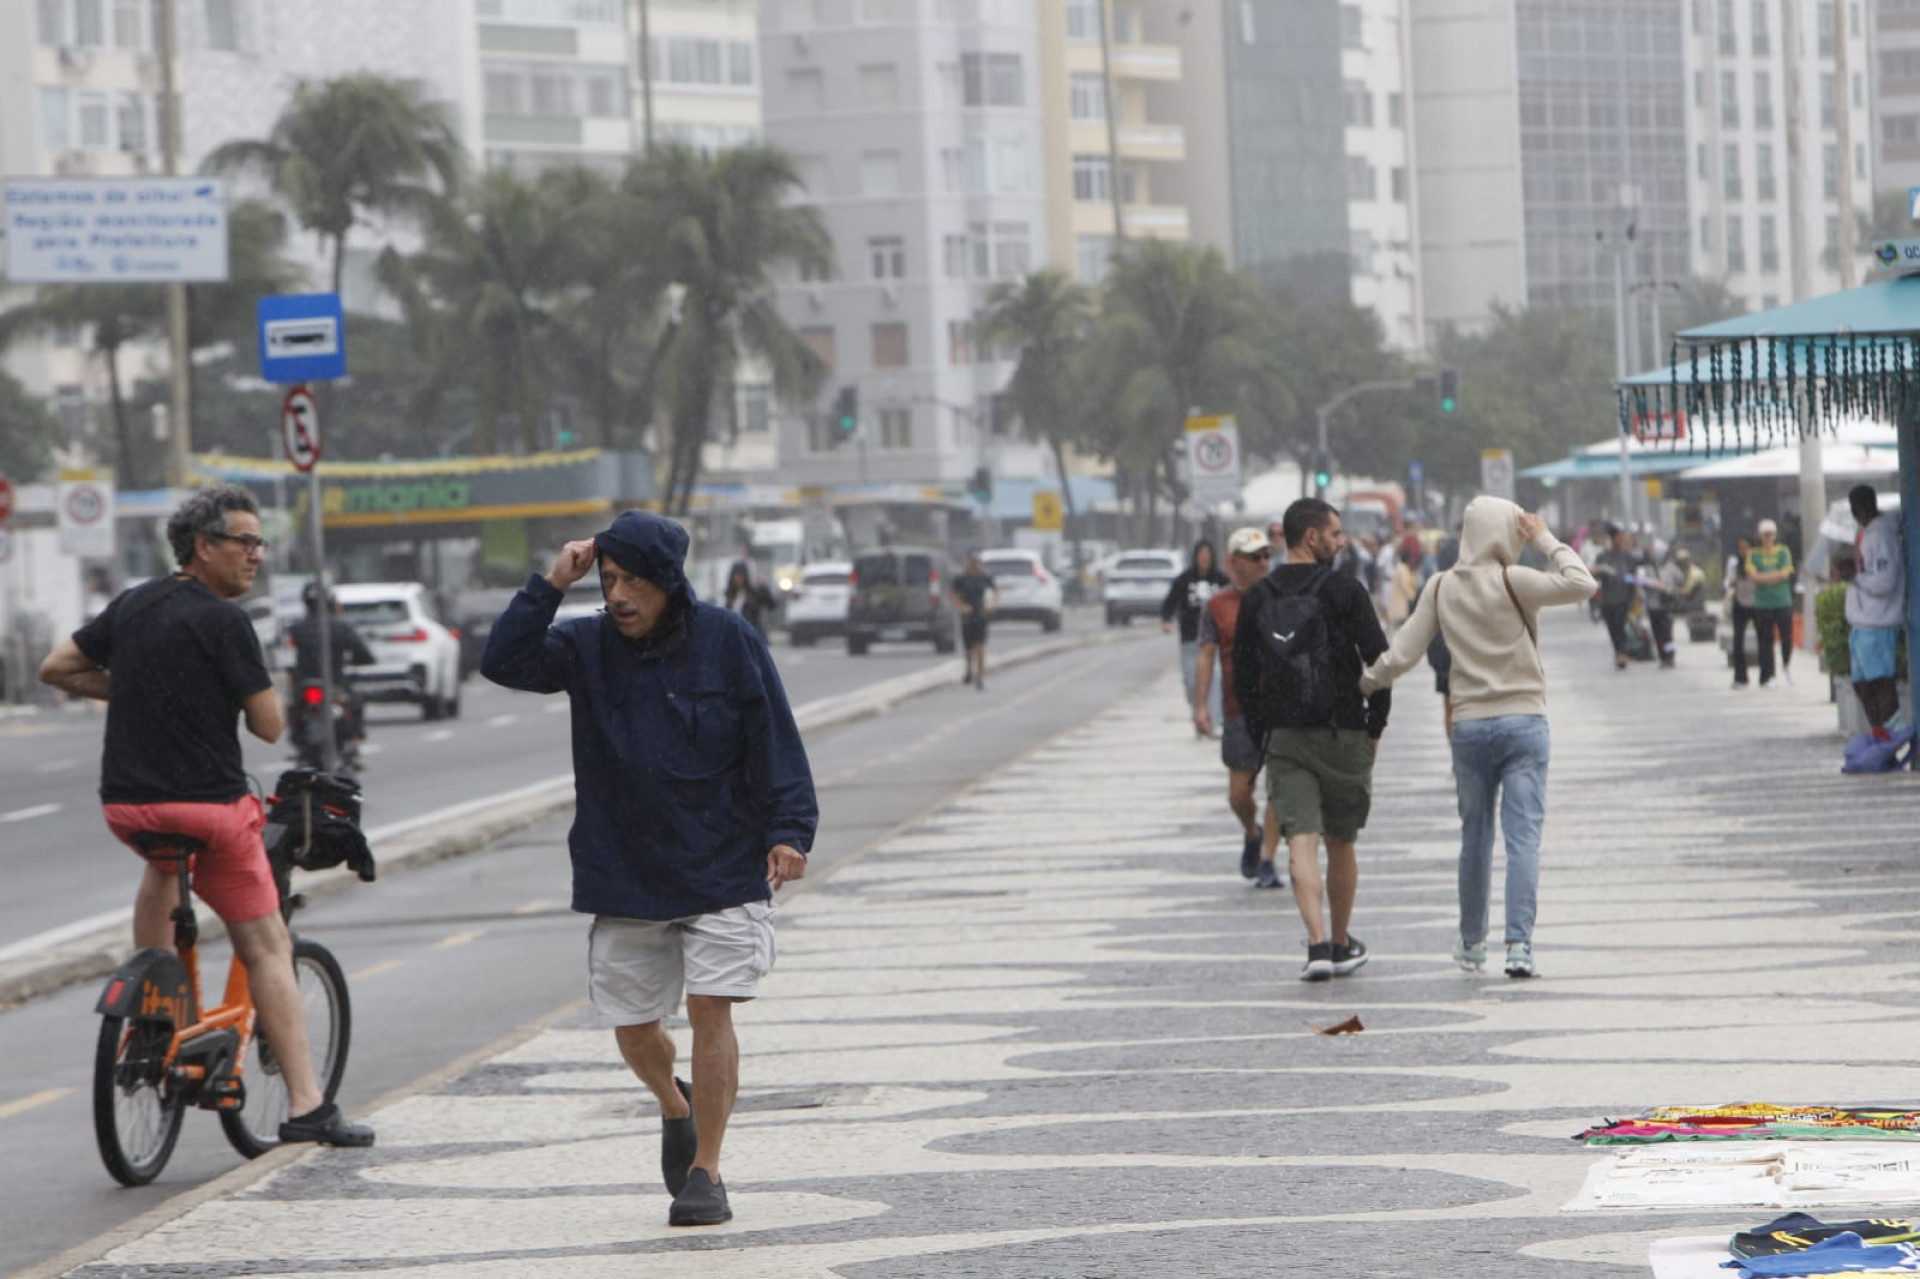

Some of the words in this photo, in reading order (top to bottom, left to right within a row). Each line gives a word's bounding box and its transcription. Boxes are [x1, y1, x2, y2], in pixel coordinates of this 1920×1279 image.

[6, 188, 95, 203] Estamos
[104, 189, 127, 203] de
[96, 213, 218, 227] monitorada
[89, 232, 198, 247] Prefeitura
